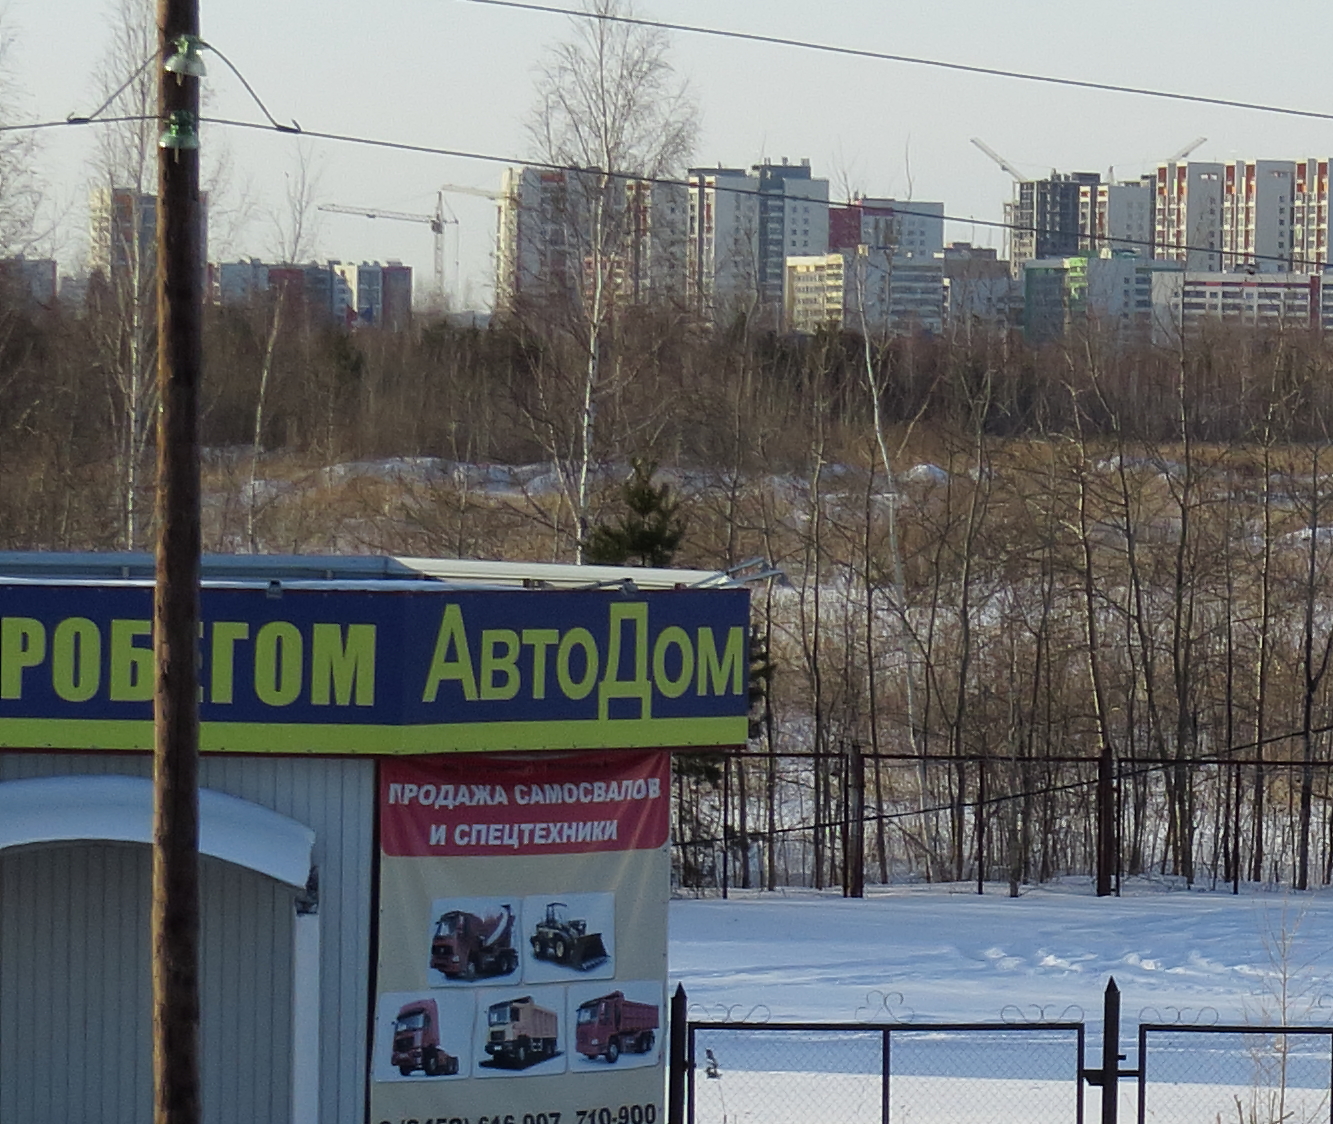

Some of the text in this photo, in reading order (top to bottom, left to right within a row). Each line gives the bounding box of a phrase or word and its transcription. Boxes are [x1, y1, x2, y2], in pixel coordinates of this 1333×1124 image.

[1, 617, 376, 706] РОБГОМ
[388, 778, 660, 809] ПРОДАЖА САМОСВАЛОВ
[429, 820, 618, 849] И СПЕЦТЕХНИКИ
